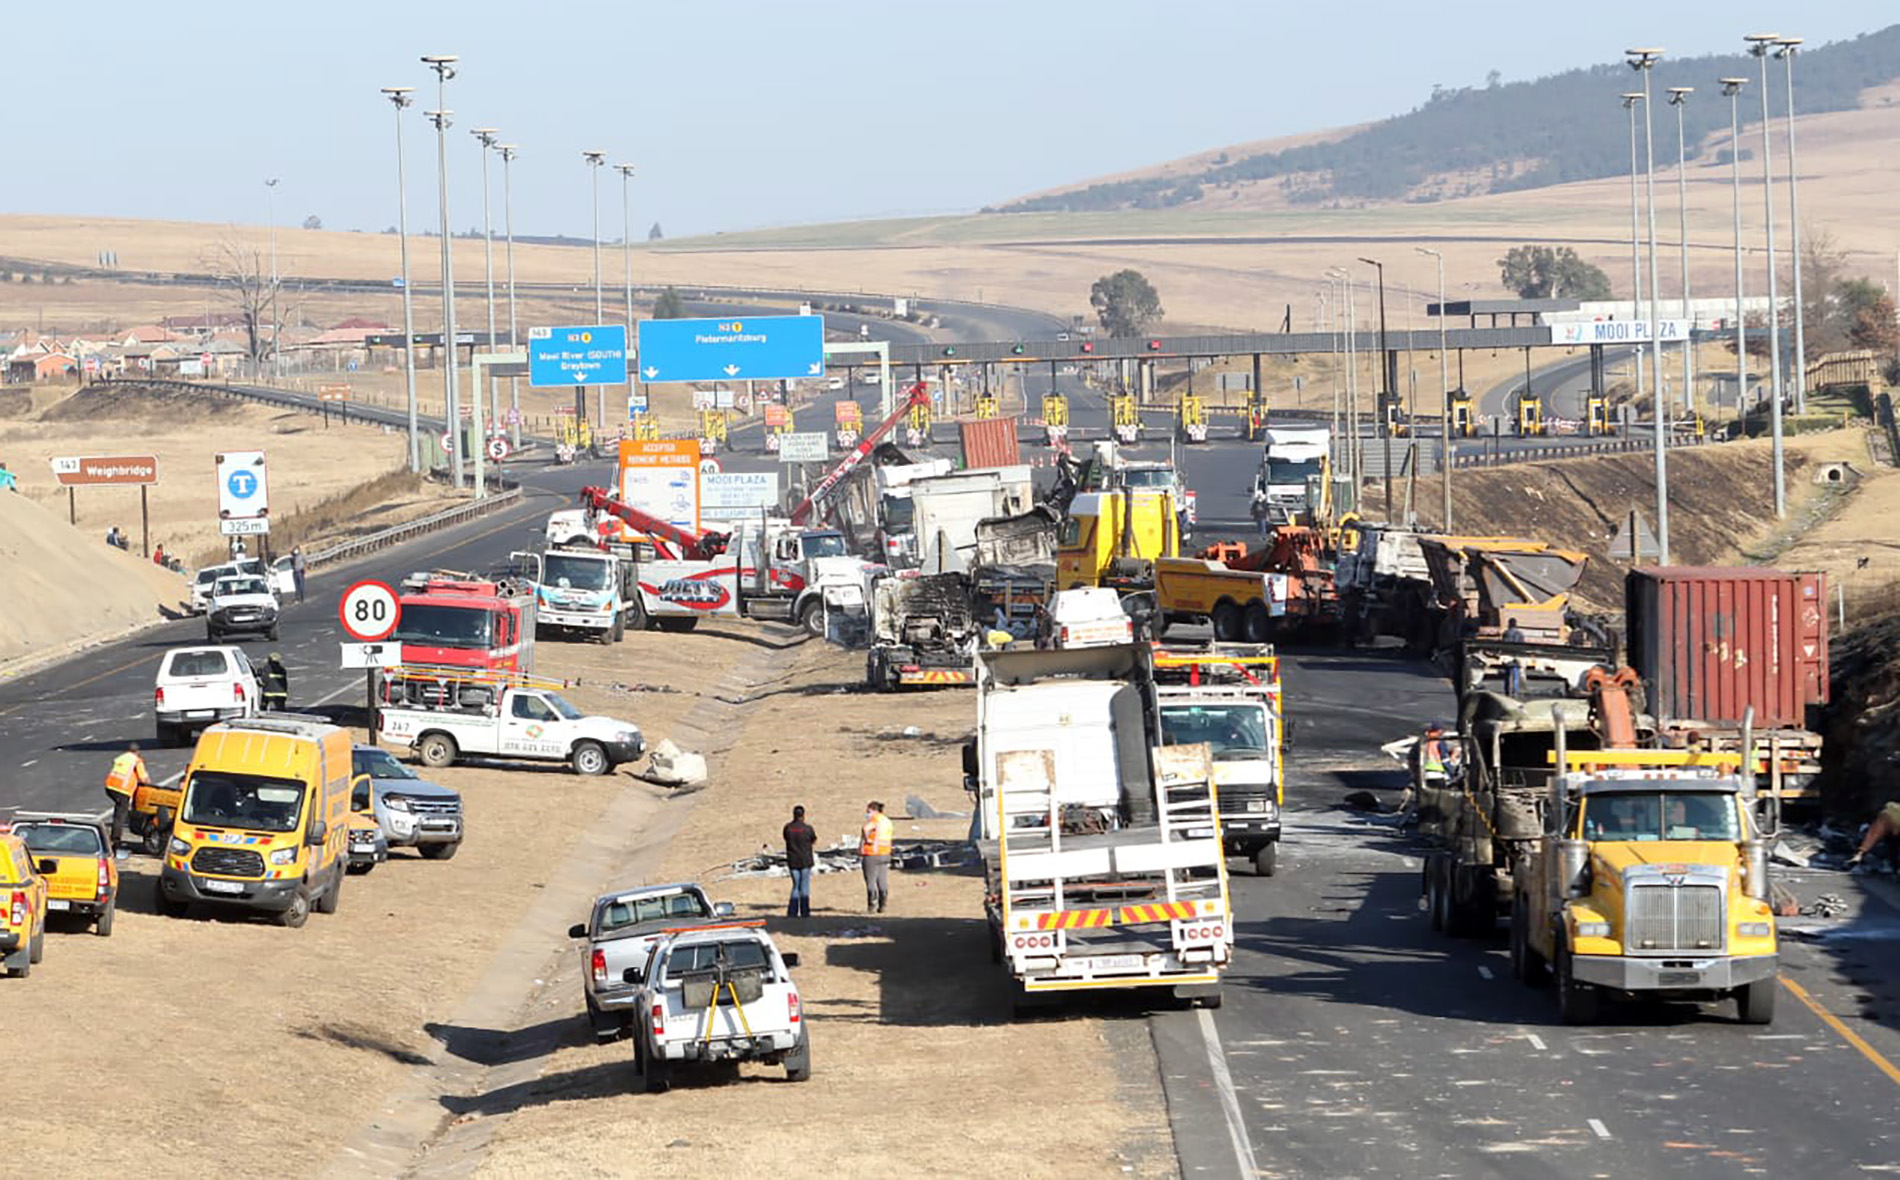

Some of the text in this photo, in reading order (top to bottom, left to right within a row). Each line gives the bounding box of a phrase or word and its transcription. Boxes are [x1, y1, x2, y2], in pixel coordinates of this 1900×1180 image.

[1594, 324, 1629, 340] MOOI
[1635, 322, 1676, 339] PLZA
[86, 465, 153, 479] Weighbridge
[734, 474, 767, 484] PLAZA
[354, 598, 386, 622] 80
